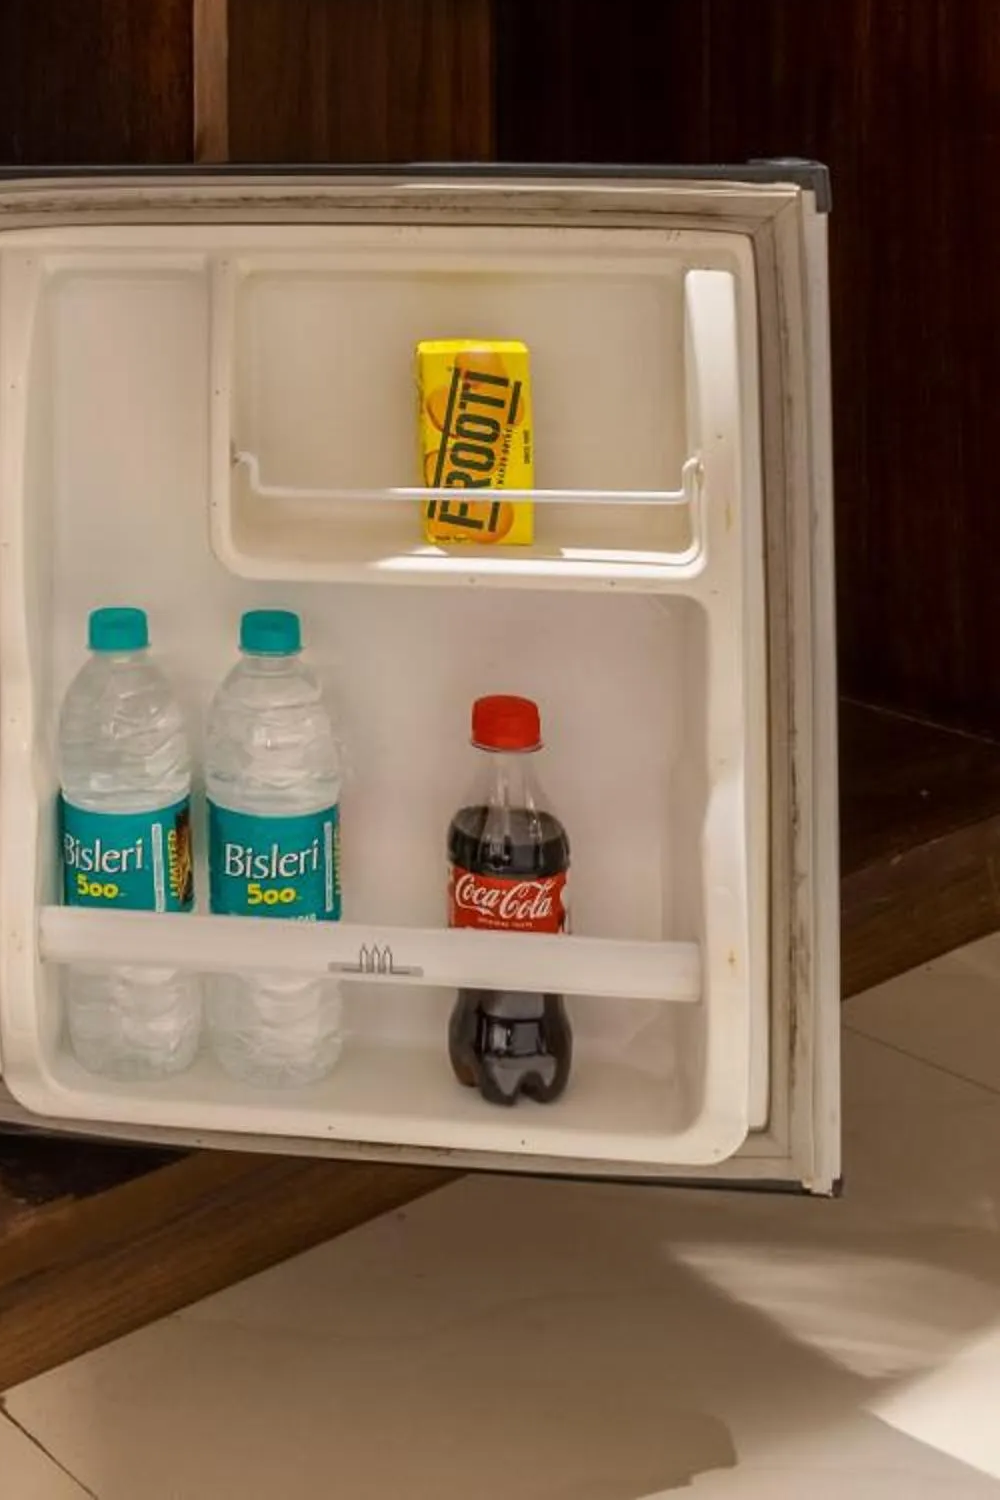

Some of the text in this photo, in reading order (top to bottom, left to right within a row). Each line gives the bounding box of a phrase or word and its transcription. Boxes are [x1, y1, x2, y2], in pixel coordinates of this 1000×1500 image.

[439, 370, 510, 530] FROOTI
[63, 832, 143, 873] Bisleri
[224, 838, 320, 880] Bisleri
[77, 873, 119, 899] 500
[247, 883, 297, 905] 500
[455, 874, 554, 920] Coca-Cola
